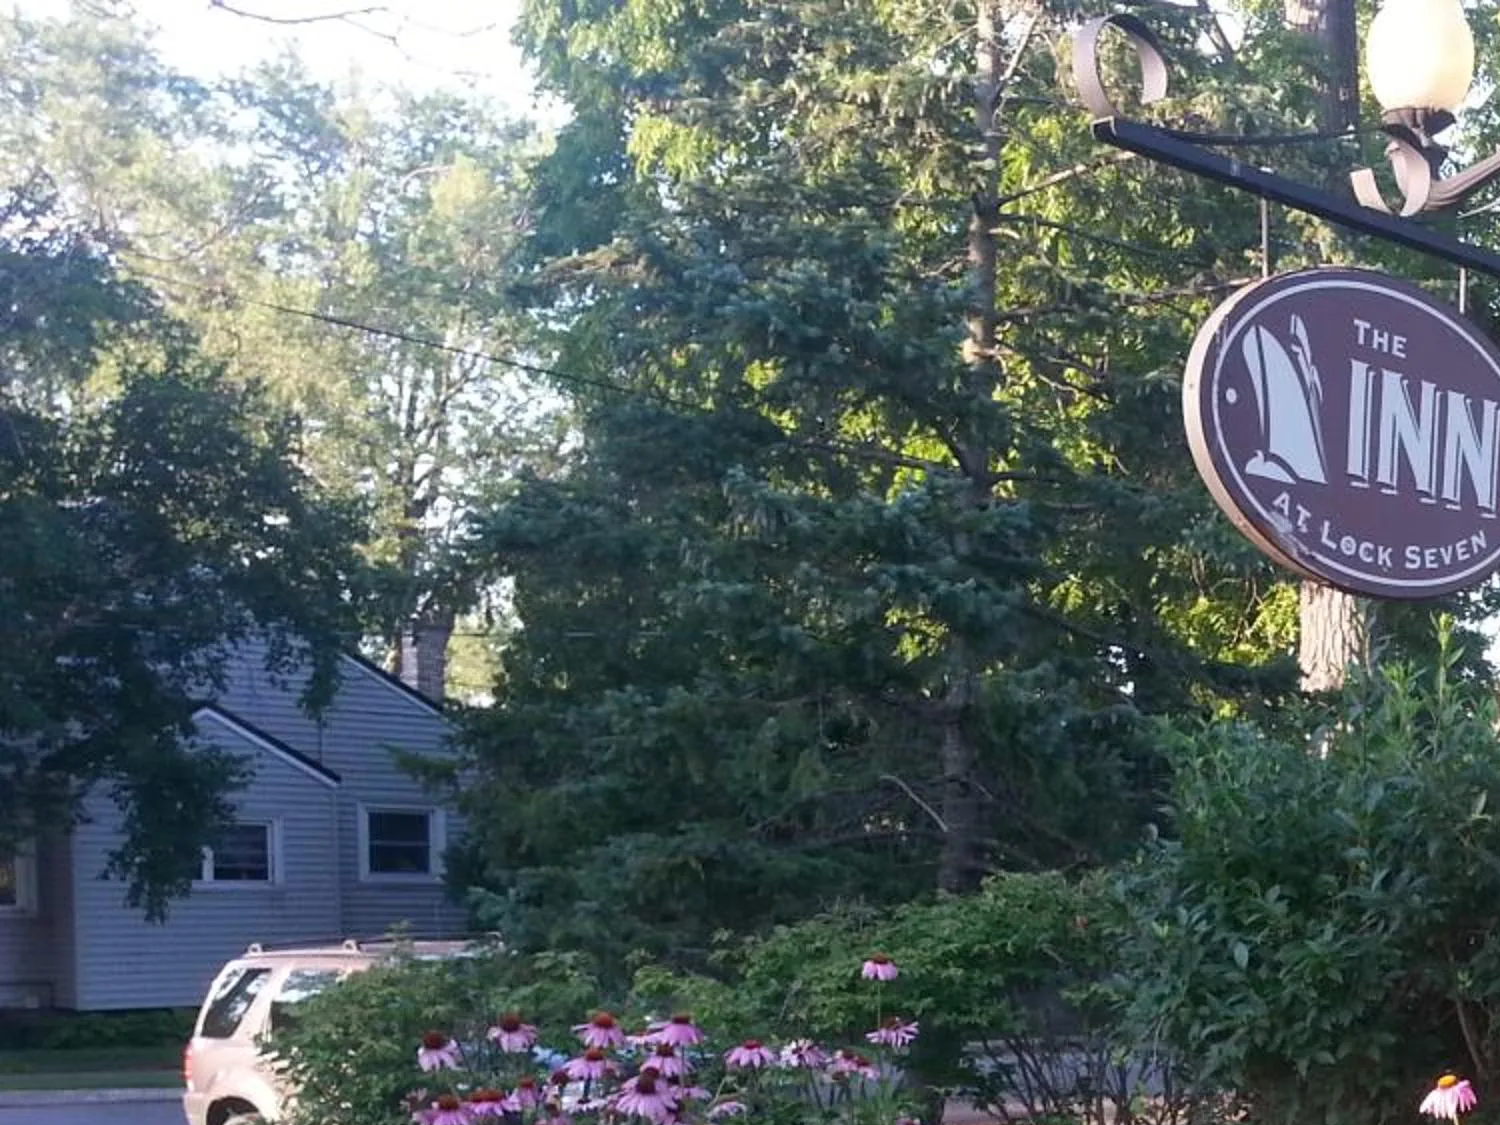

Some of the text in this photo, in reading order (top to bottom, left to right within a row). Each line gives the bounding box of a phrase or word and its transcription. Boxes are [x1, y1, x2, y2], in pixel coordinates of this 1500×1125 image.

[1353, 319, 1407, 359] THE
[1273, 491, 1488, 569] AT LOCK SEVEN
